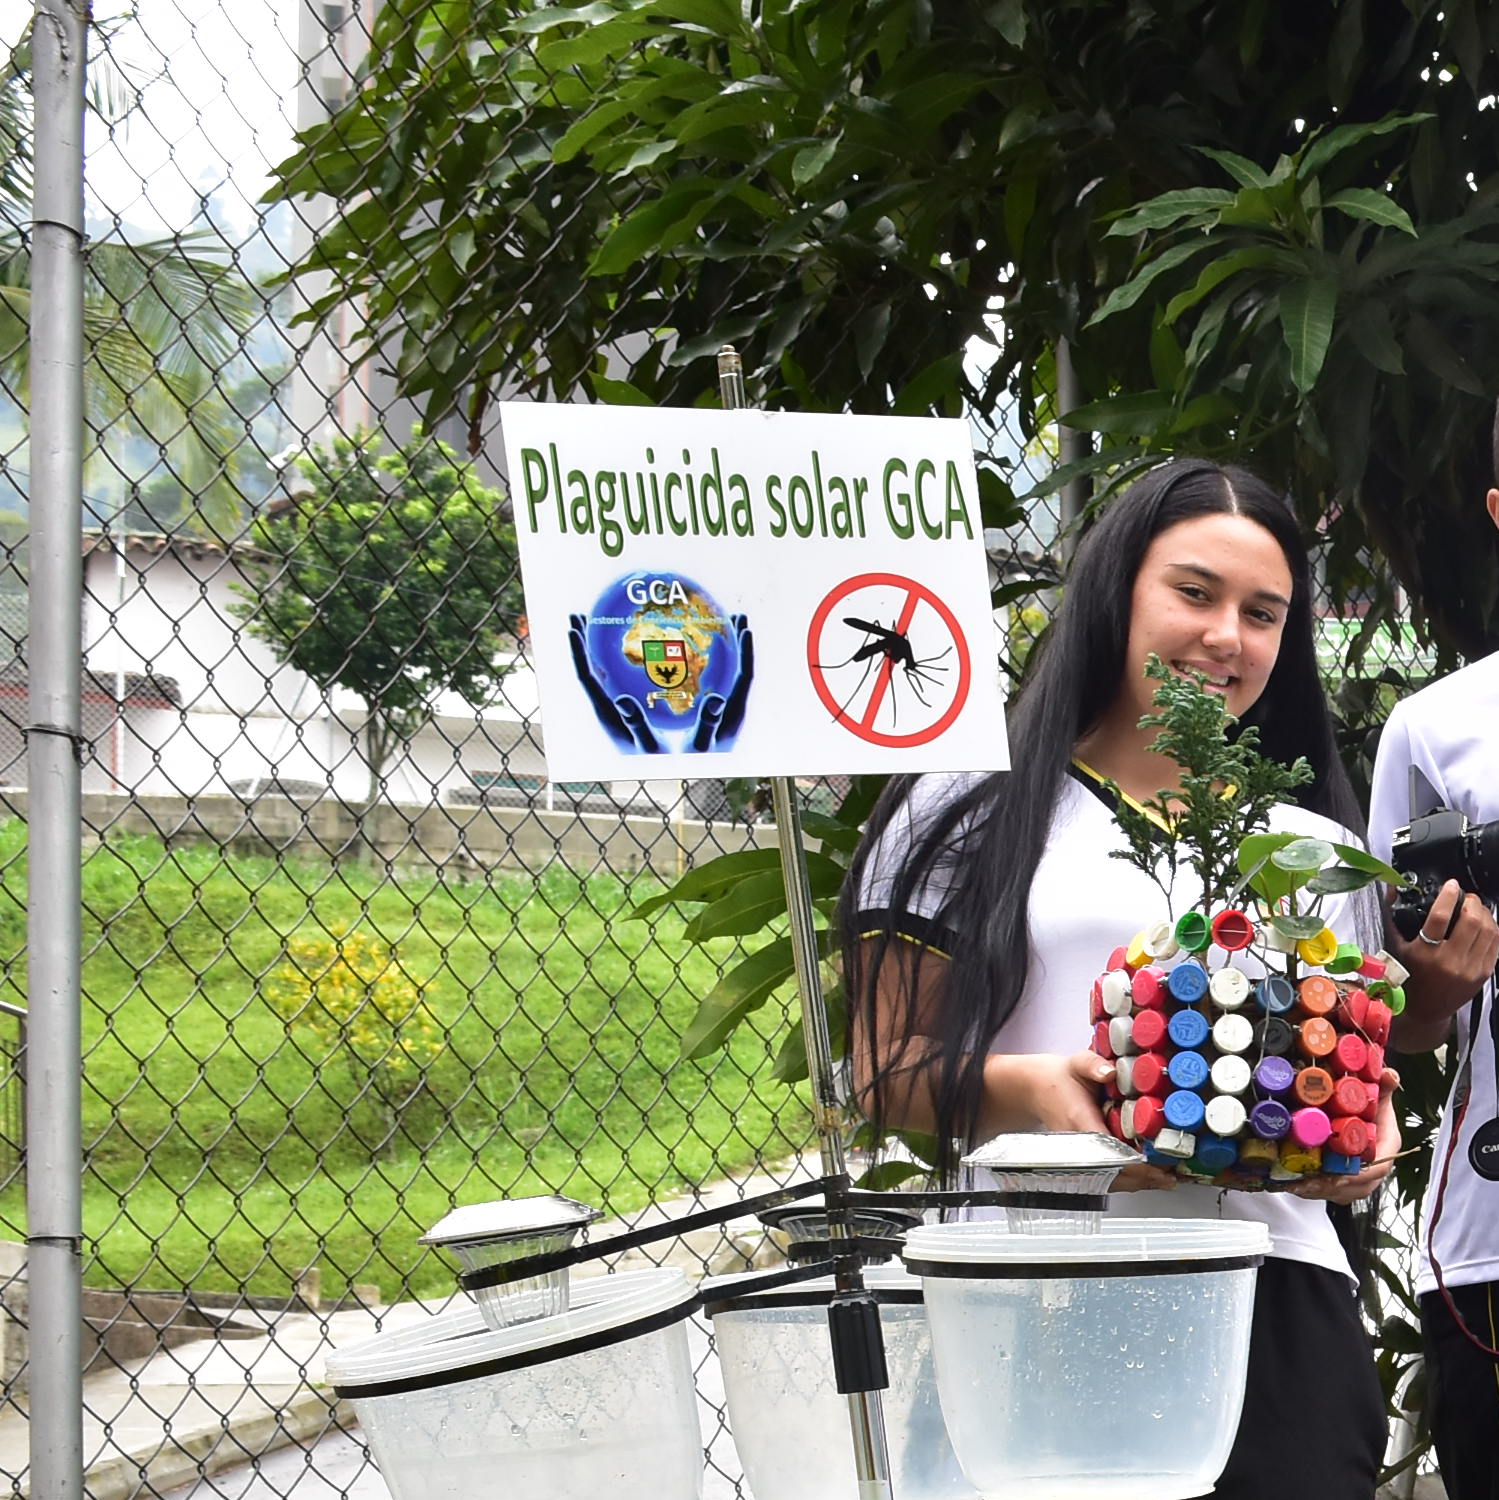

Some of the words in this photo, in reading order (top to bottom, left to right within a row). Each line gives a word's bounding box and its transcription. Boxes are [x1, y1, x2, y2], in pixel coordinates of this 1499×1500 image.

[520, 442, 755, 557] Plaguicida
[765, 450, 868, 539] solar
[883, 458, 974, 540] GCA
[626, 580, 688, 605] GCA
